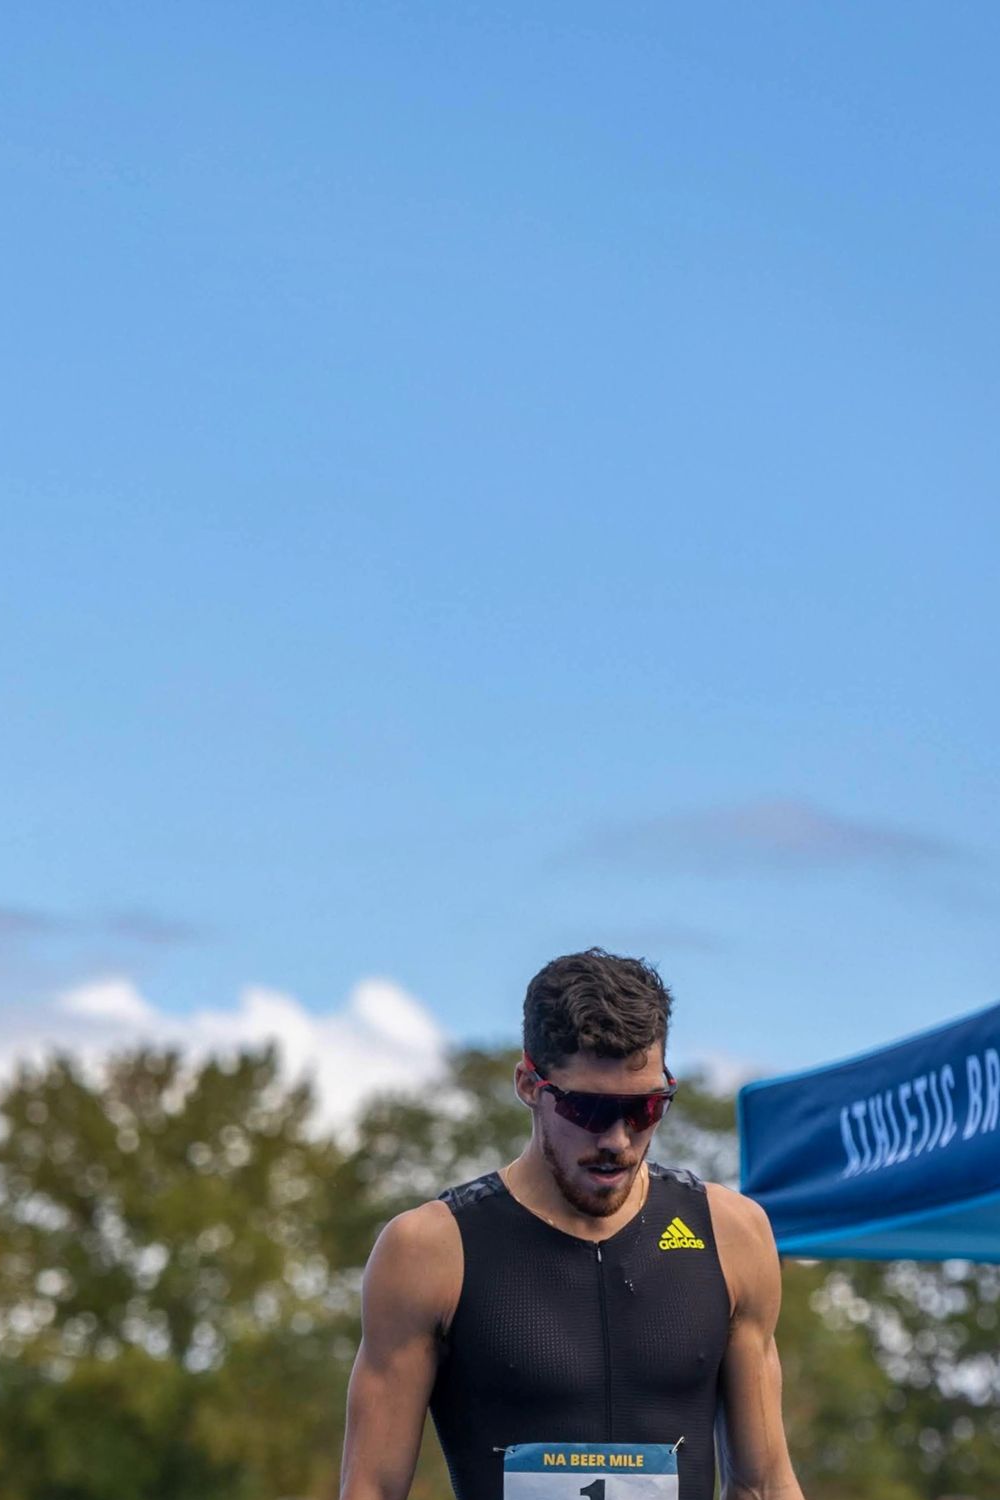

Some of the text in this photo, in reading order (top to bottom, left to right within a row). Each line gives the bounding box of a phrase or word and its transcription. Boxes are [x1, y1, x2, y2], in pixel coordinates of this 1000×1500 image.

[839, 1063, 958, 1180] ATHLETIC
[658, 1236, 705, 1250] adidas
[543, 1453, 644, 1467] NA BEER MILE
